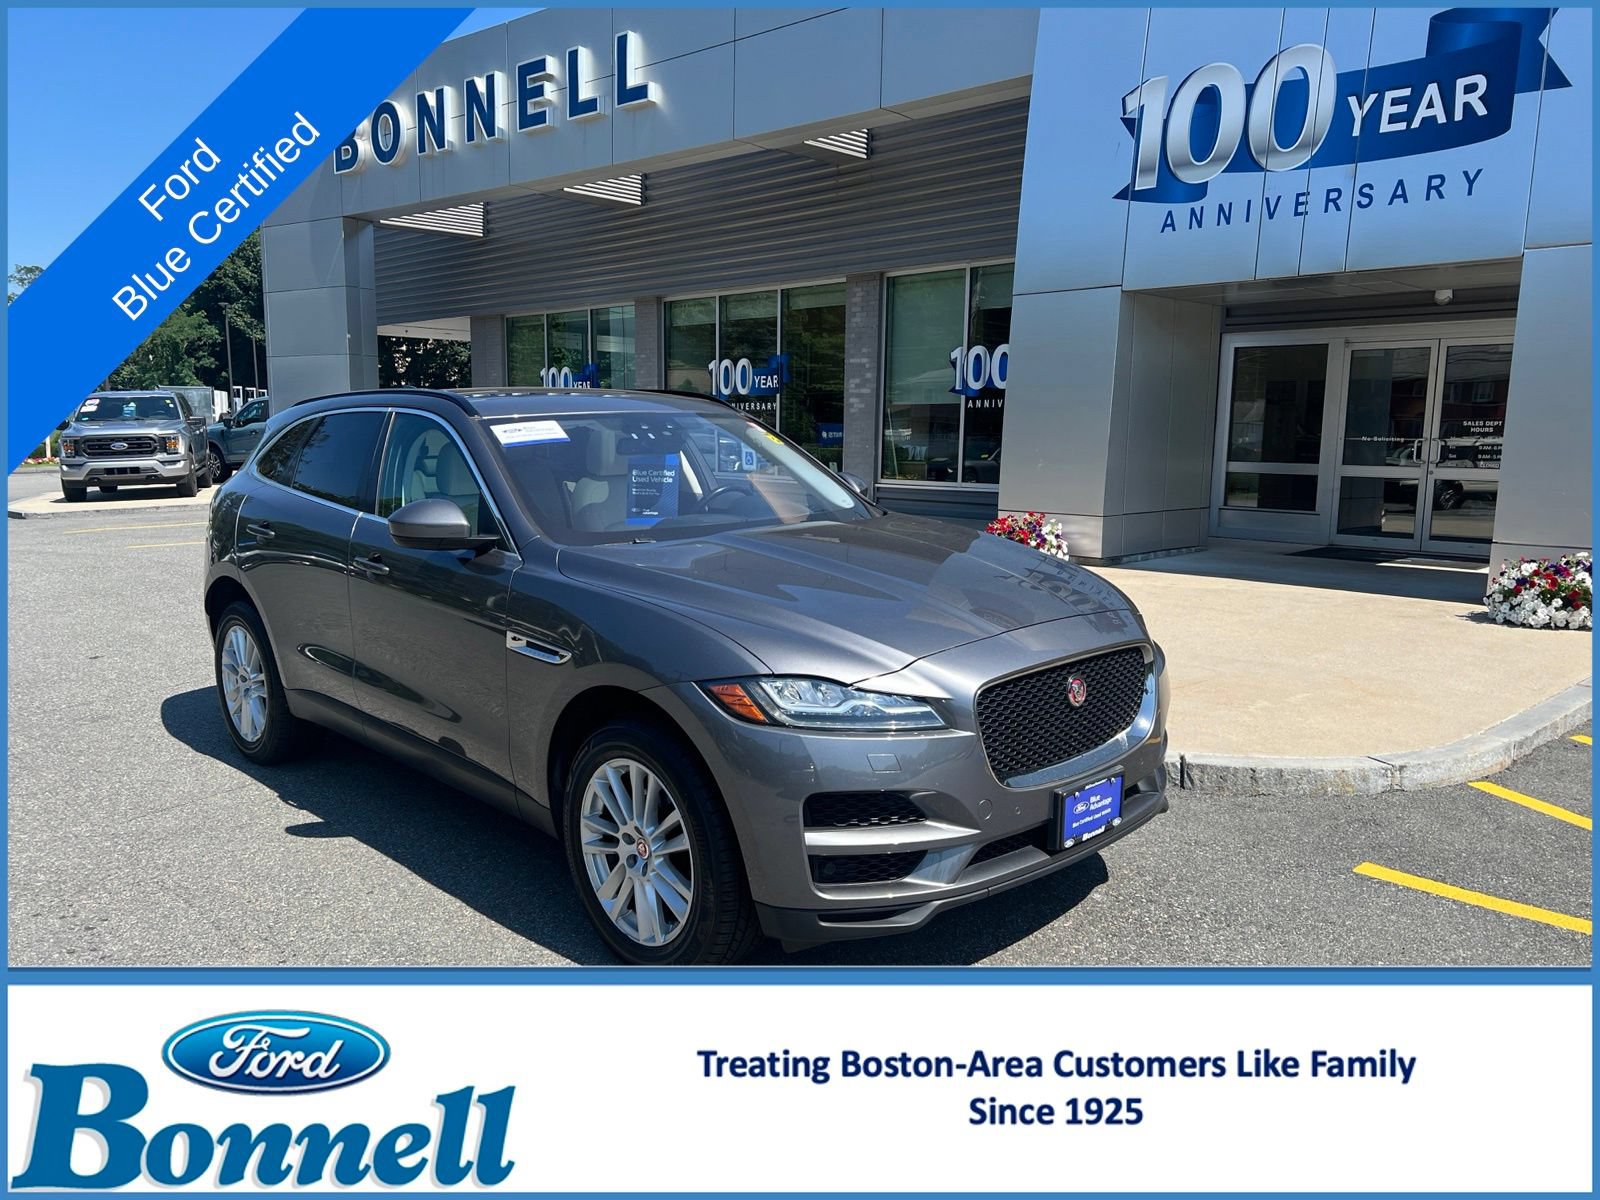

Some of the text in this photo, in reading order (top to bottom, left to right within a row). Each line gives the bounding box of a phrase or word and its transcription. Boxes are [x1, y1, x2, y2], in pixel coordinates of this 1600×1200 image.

[333, 30, 656, 175] BONNELL
[1122, 43, 1489, 191] 100 YEAR
[1160, 168, 1483, 234] ANNIVERSARY
[540, 366, 573, 388] 100
[708, 357, 779, 396] 100 YEAR
[950, 343, 1009, 390] 100
[967, 399, 1003, 408] ANNIV
[1090, 797, 1112, 810] Advantage
